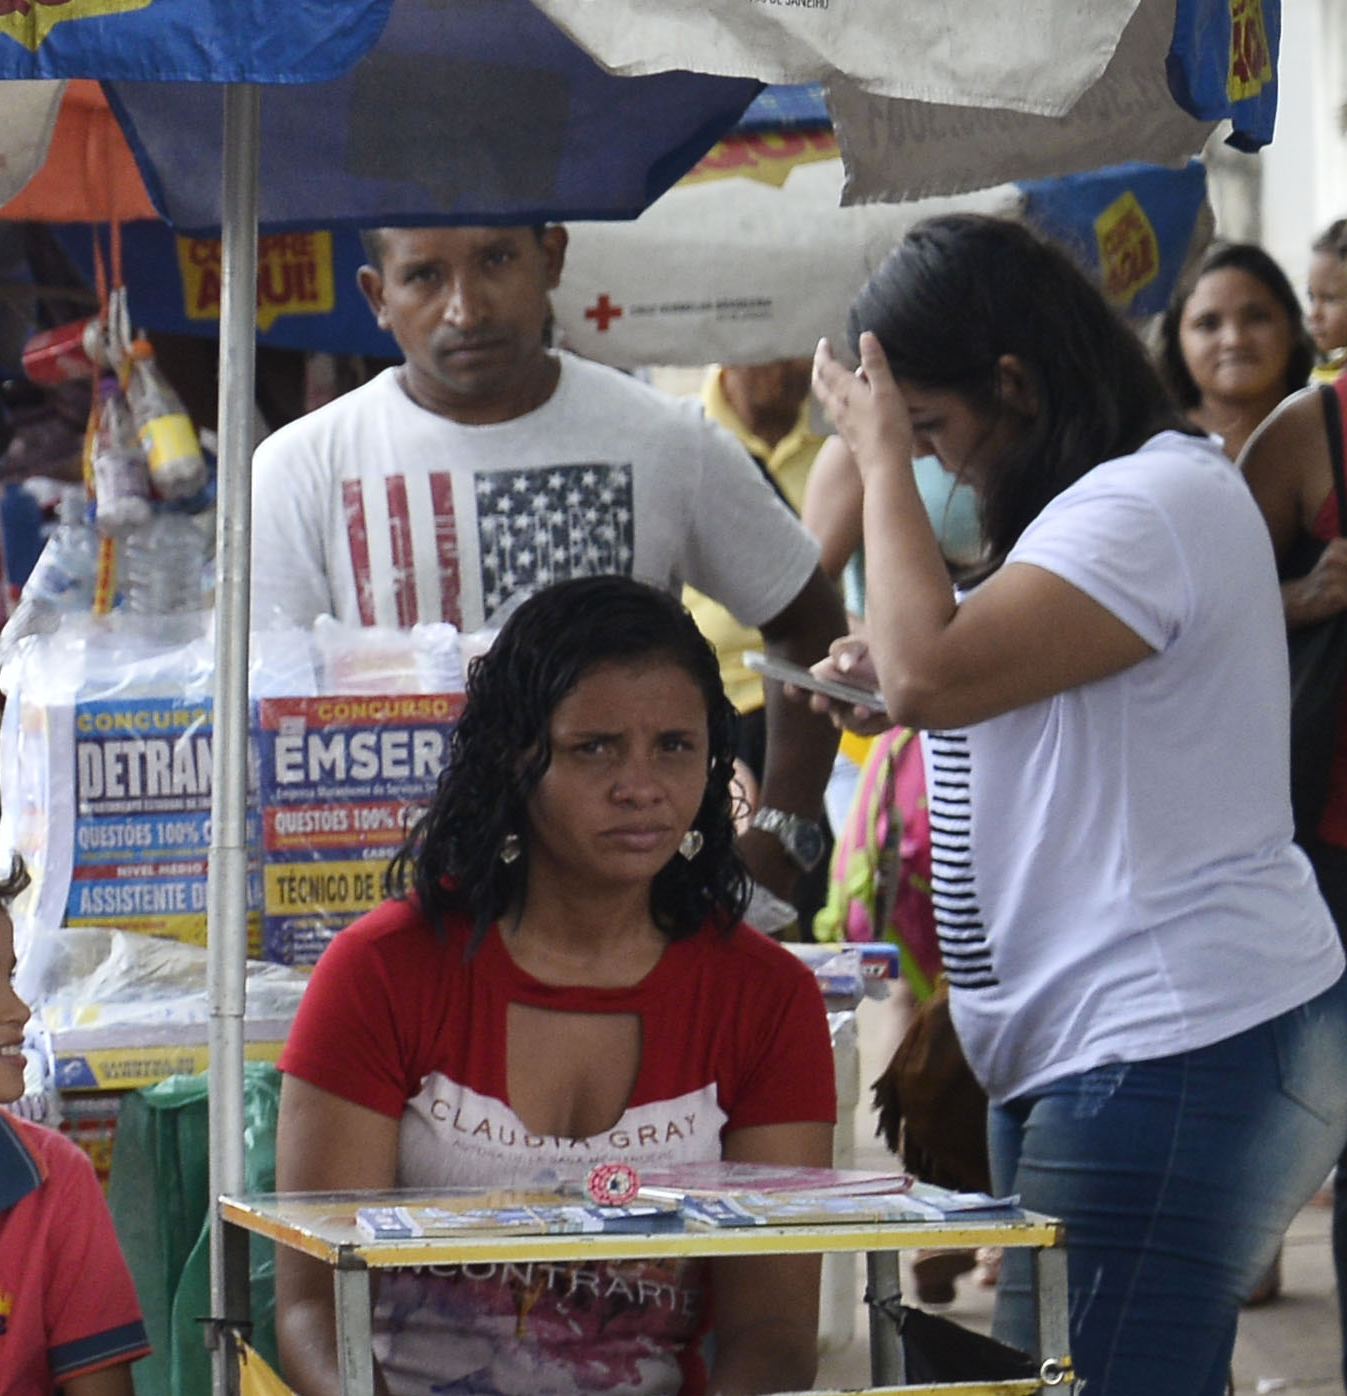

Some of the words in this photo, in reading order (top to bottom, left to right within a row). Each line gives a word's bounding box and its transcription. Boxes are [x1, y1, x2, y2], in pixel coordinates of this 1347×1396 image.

[78, 708, 214, 733] CONCURS
[319, 700, 449, 720] CONCURSO
[80, 882, 187, 915] ASSISTENTE
[277, 869, 348, 904] TÉCNICO
[610, 1113, 696, 1149] GRAY
